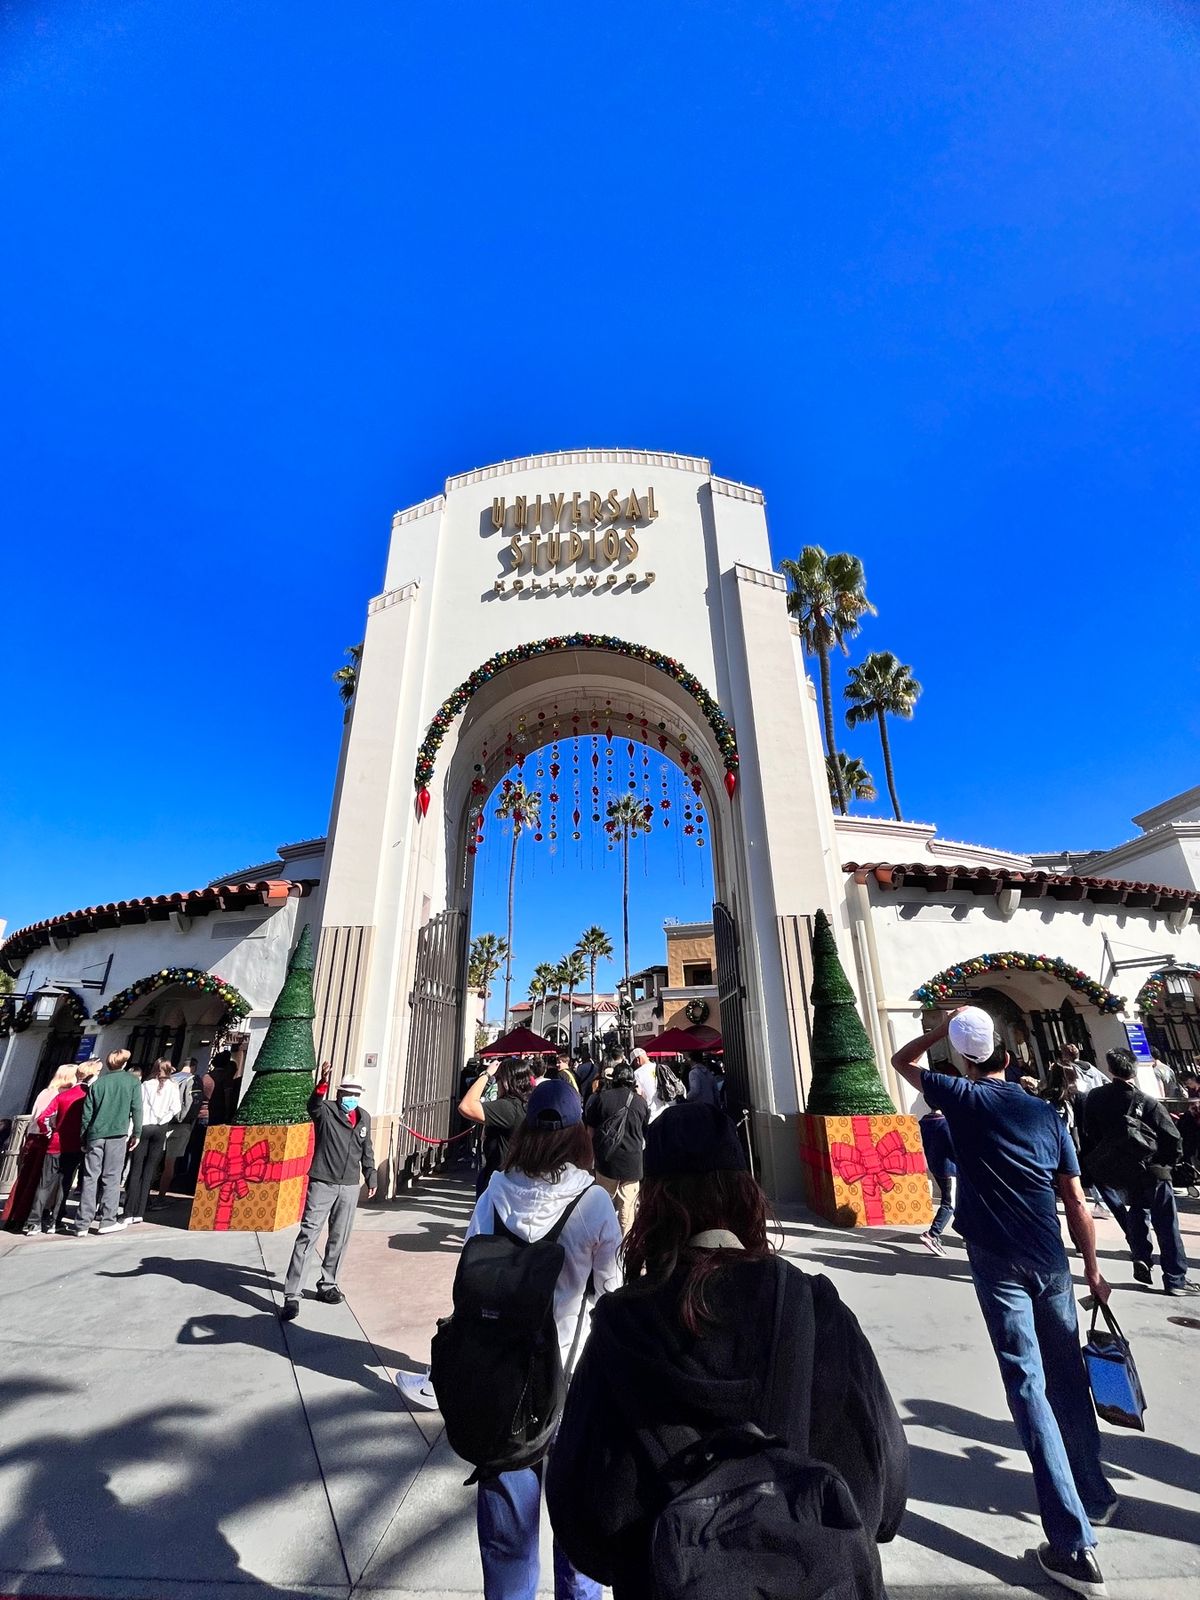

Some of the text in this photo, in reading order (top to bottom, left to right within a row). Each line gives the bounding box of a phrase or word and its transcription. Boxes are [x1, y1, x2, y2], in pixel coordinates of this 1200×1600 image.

[491, 486, 659, 528] UNIVERSAL
[510, 527, 639, 569] STUDIOS
[494, 571, 656, 593] HOLLYWOOD
